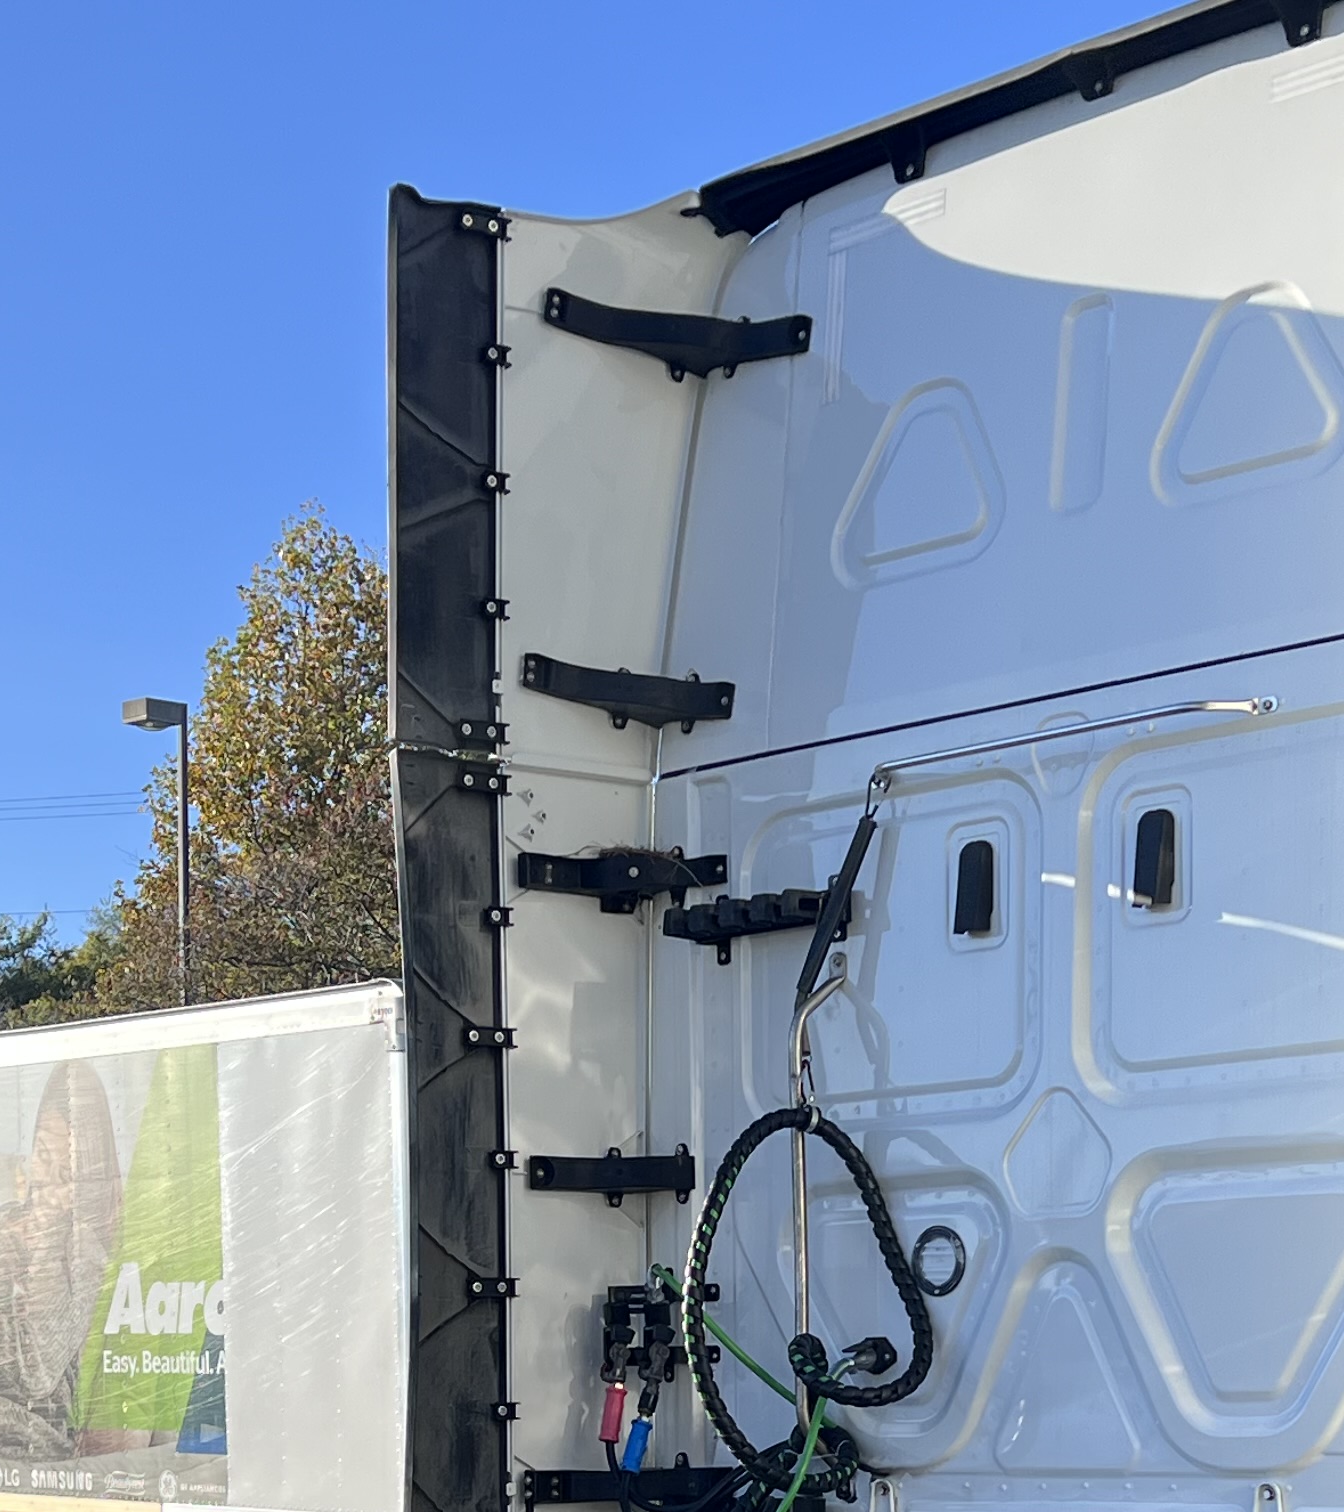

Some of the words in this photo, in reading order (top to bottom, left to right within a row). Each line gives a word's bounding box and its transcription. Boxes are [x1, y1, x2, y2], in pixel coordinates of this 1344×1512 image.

[102, 1349, 140, 1378] Easy.
[142, 1349, 214, 1375] Beautiful.
[4, 1468, 20, 1487] LG
[31, 1469, 93, 1491] SAMSUNG
